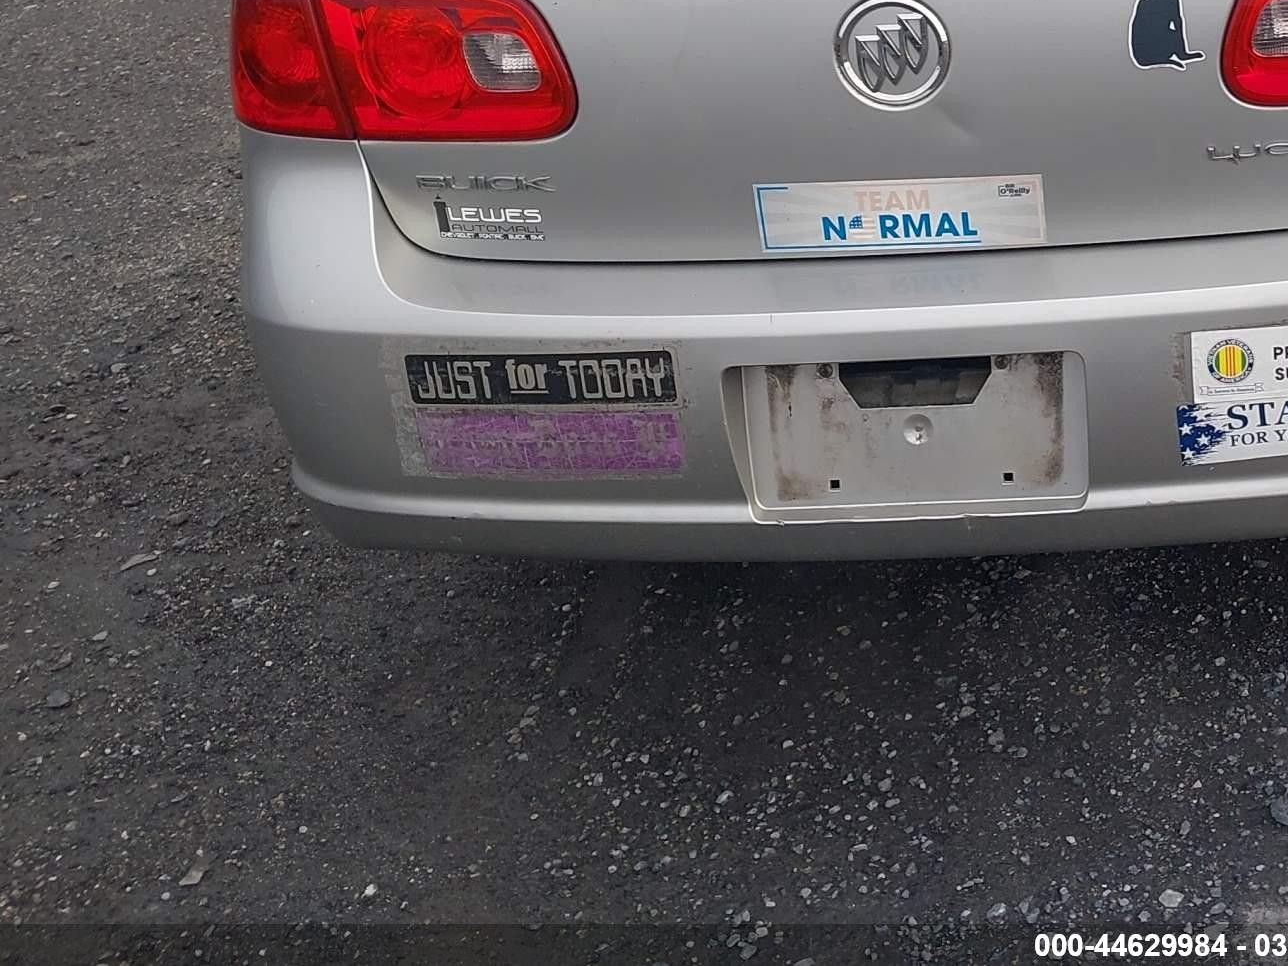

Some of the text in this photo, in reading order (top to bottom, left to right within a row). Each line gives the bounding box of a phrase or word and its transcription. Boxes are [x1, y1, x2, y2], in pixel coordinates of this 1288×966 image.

[415, 173, 557, 193] BUICK
[854, 190, 930, 211] TEAM
[447, 207, 542, 223] LEWES
[451, 224, 544, 233] AUTOMALL
[417, 357, 665, 399] JUST for TODAY
[1231, 431, 1269, 446] FOR
